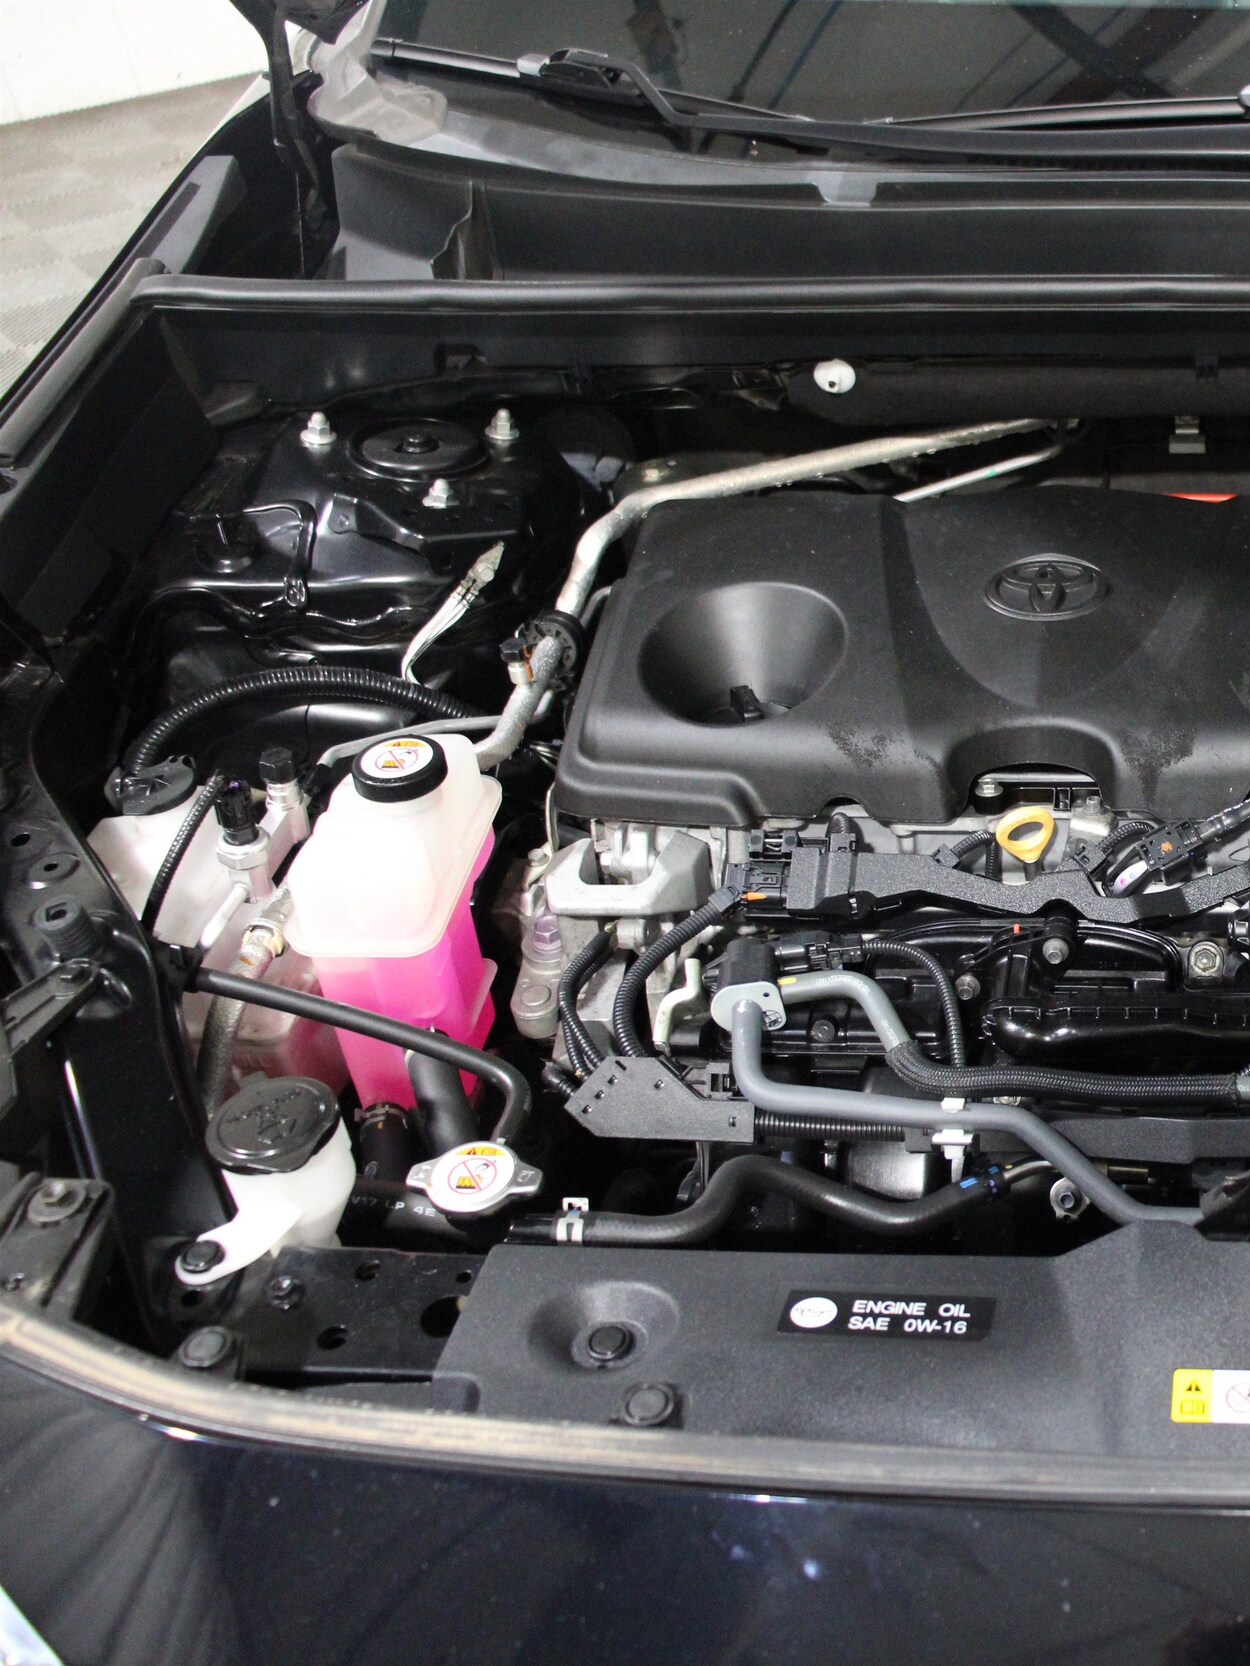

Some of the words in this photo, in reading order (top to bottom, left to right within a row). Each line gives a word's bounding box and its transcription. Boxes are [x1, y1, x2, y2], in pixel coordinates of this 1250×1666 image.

[852, 1300, 927, 1316] ENGINE
[938, 1303, 971, 1318] OIL
[848, 1316, 890, 1331] SAE
[903, 1319, 967, 1334] 0W-16
